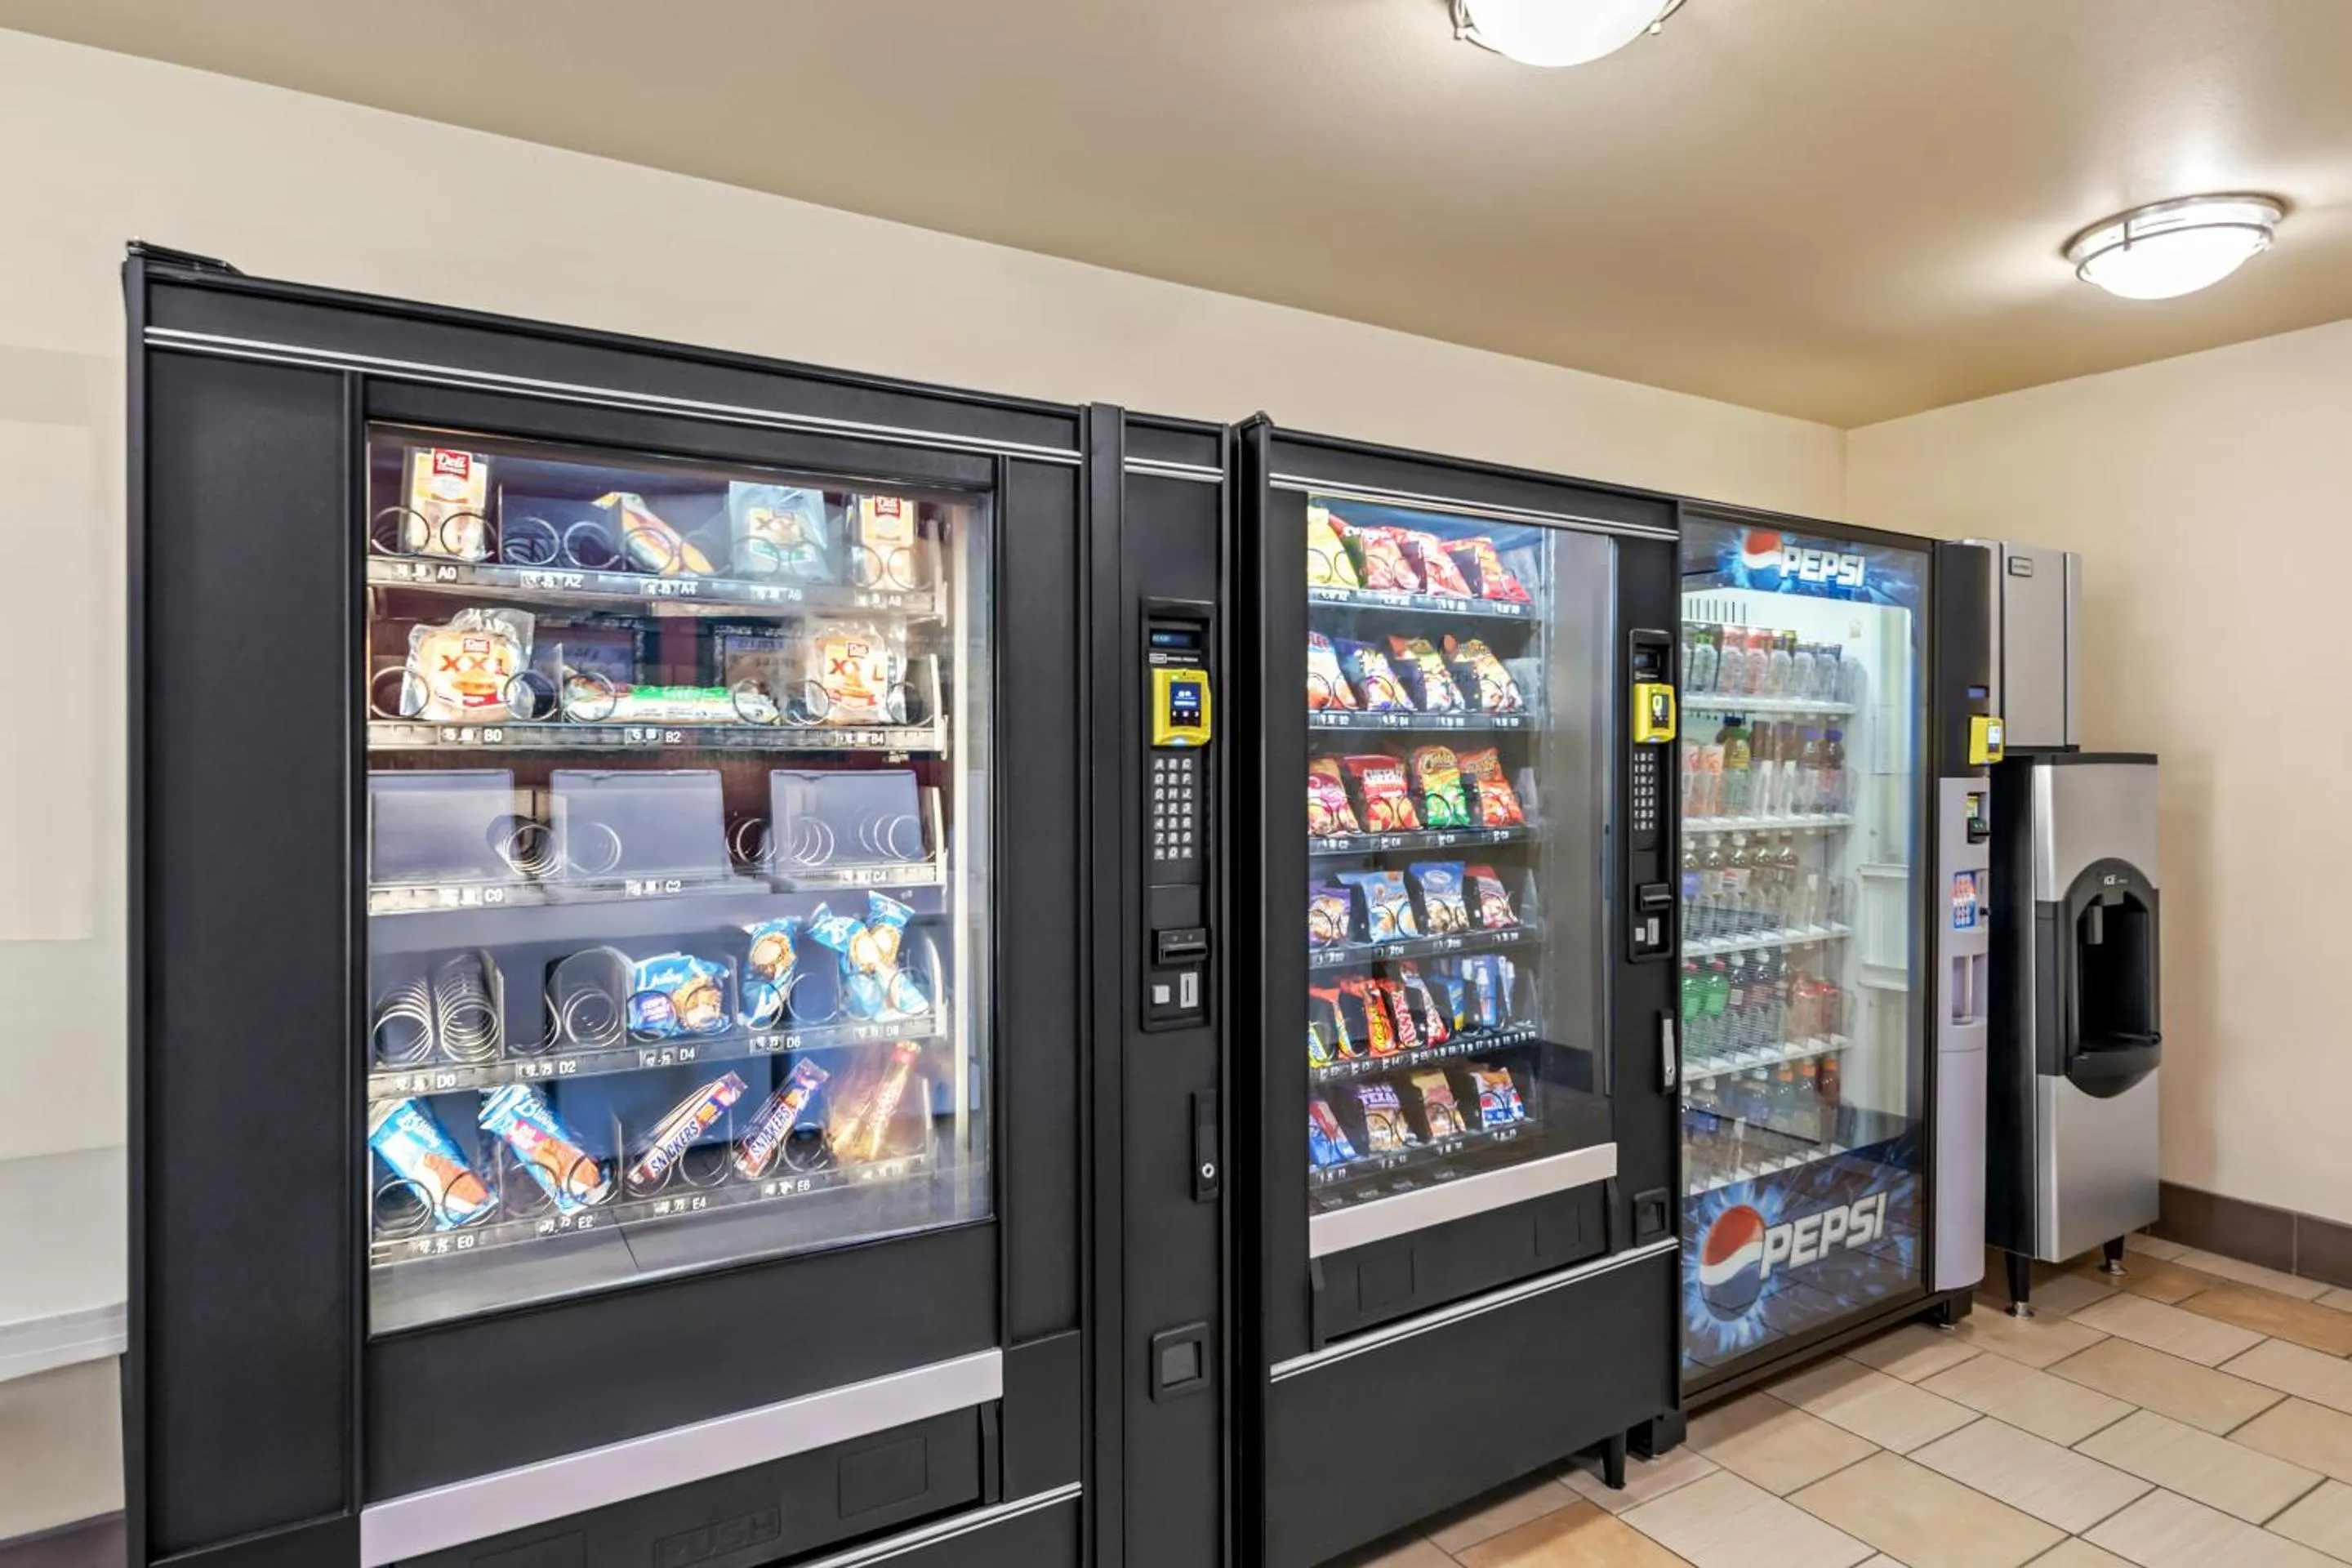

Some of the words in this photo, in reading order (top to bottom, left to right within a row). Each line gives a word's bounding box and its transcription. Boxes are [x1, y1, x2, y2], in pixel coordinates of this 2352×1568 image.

[438, 565, 457, 580] A0
[1780, 546, 1865, 587] PEPSI
[483, 728, 502, 742] B0
[680, 1049, 695, 1061] D4
[559, 1061, 576, 1074] D2
[437, 1074, 456, 1089] D0
[693, 1196, 706, 1209] E4
[578, 1215, 594, 1229] E2
[457, 1235, 474, 1249] E0
[1760, 1192, 1888, 1281] PEPSI
